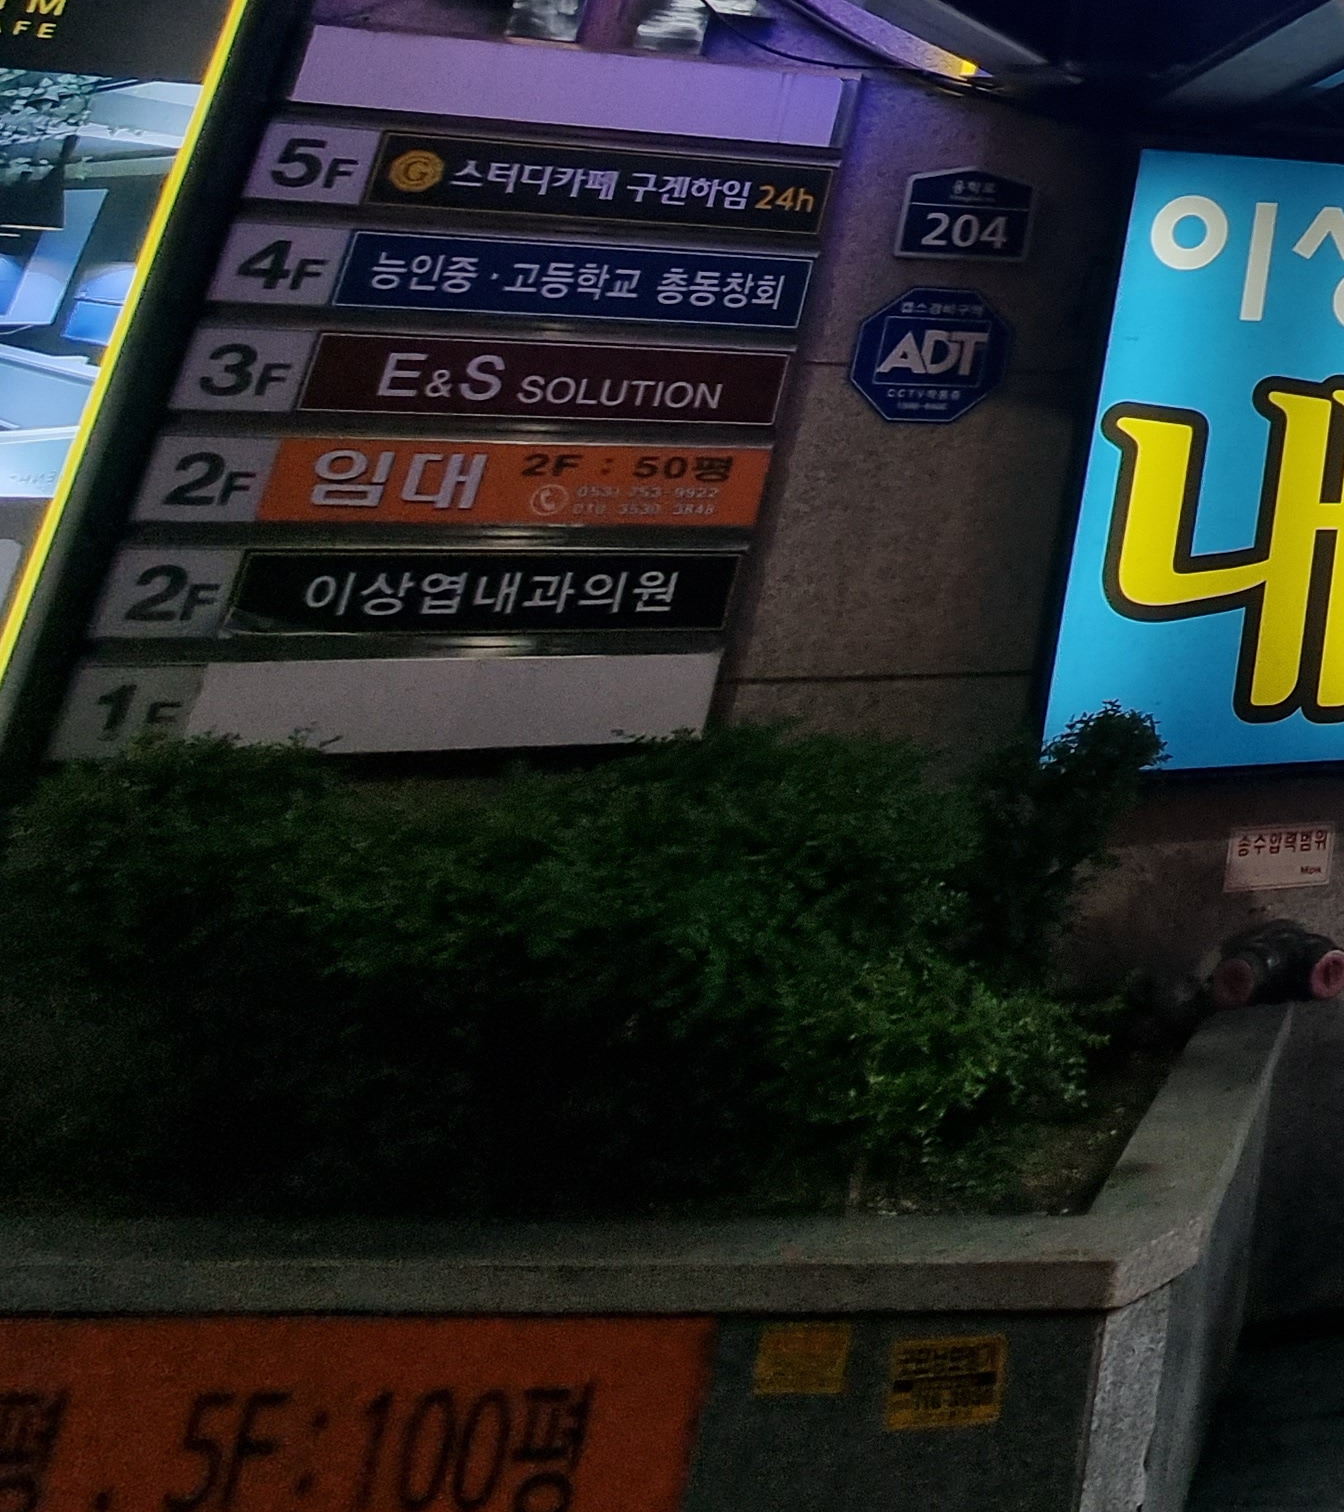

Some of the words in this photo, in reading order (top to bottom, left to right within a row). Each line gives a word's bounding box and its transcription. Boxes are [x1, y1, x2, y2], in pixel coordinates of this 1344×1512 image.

[270, 137, 359, 189] 5F
[449, 159, 621, 201] 스터디카페
[626, 172, 753, 210] 구겐하임
[754, 185, 815, 214] 24h
[920, 212, 1008, 250] 204
[236, 239, 330, 291] 4F
[656, 267, 786, 311] 총동창회
[200, 343, 293, 397] 3F
[376, 352, 506, 402] E&S
[517, 375, 724, 411] SOLUTION
[875, 329, 991, 377] ADT
[164, 451, 257, 508] 2F
[310, 447, 490, 511] 임대
[521, 453, 584, 477] 2F
[632, 455, 734, 483] 50평
[126, 564, 222, 623] 2F
[304, 571, 681, 617] 이상엽내과의원
